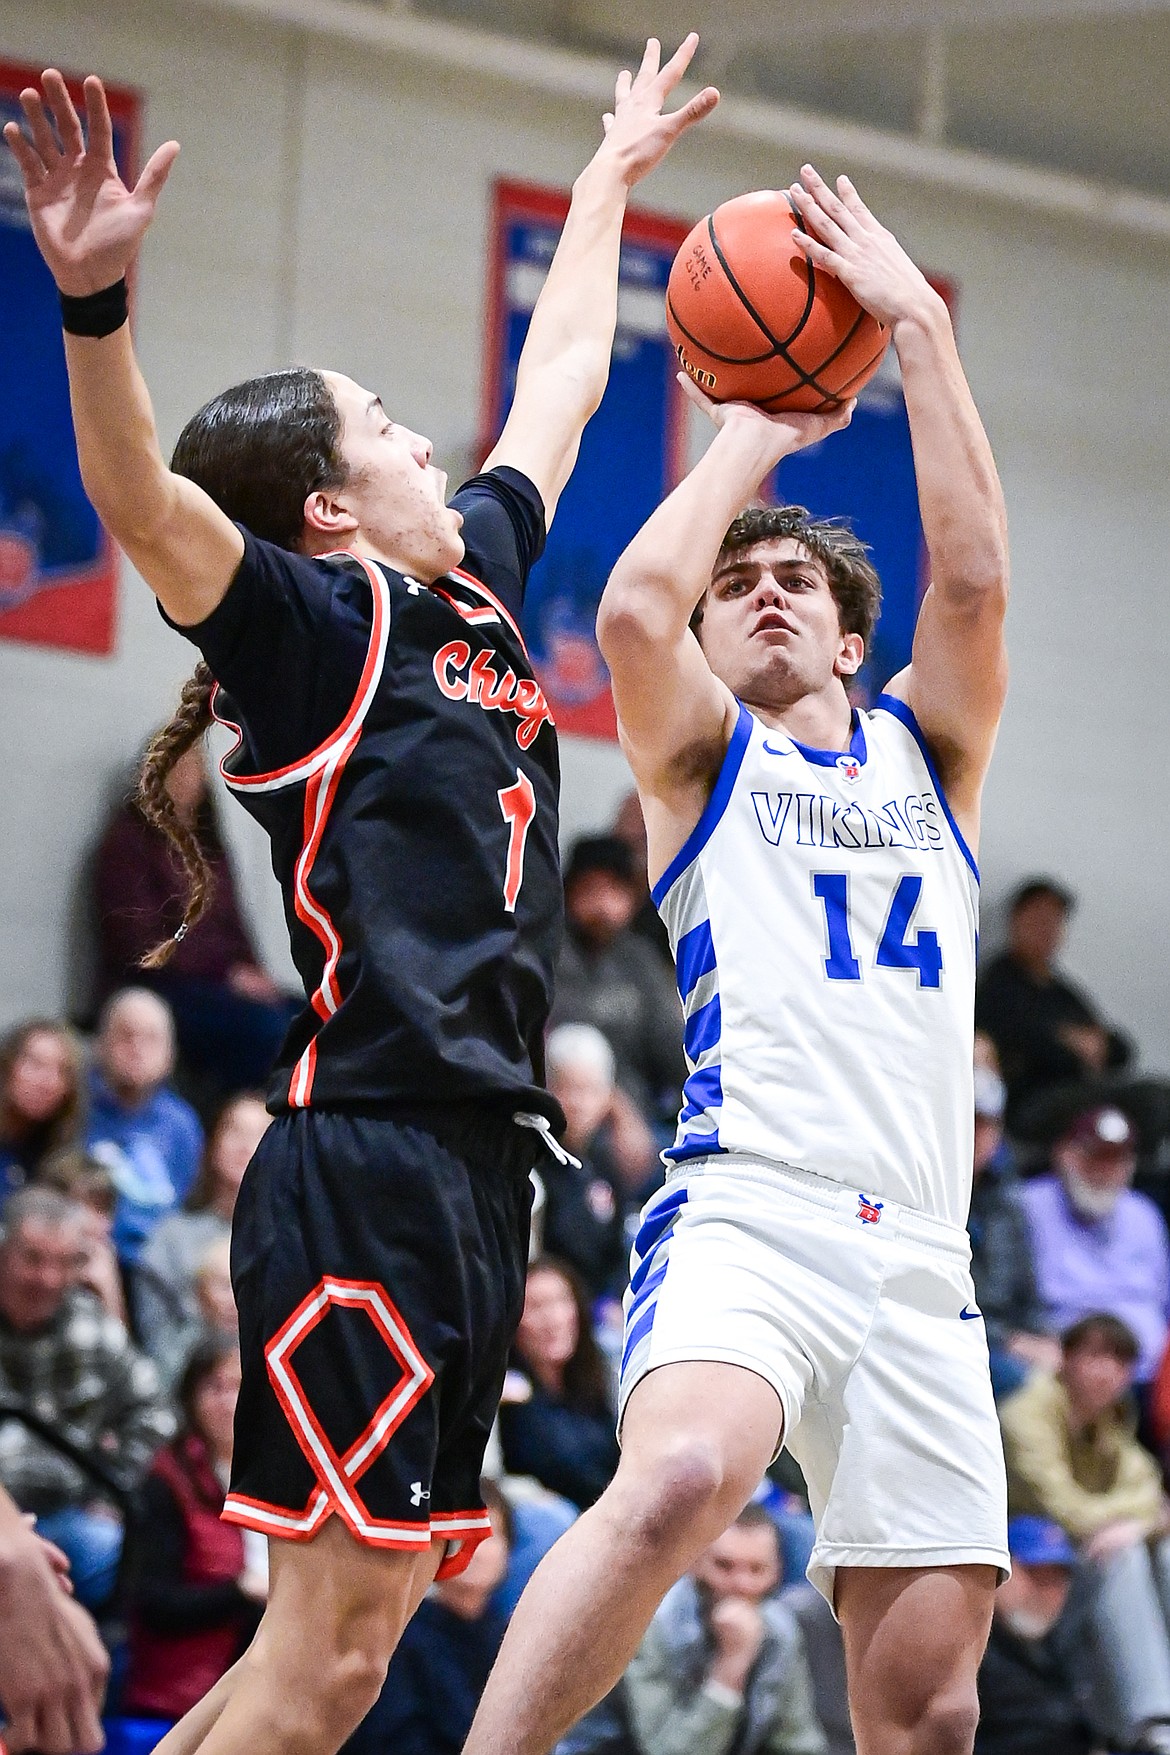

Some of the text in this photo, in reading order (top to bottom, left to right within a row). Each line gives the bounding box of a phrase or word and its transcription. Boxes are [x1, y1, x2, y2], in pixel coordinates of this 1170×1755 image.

[692, 244, 712, 280] GAME
[432, 640, 555, 750] Chief
[497, 767, 537, 913] 1
[750, 792, 944, 851] VIKINGS
[810, 870, 946, 992] 14
